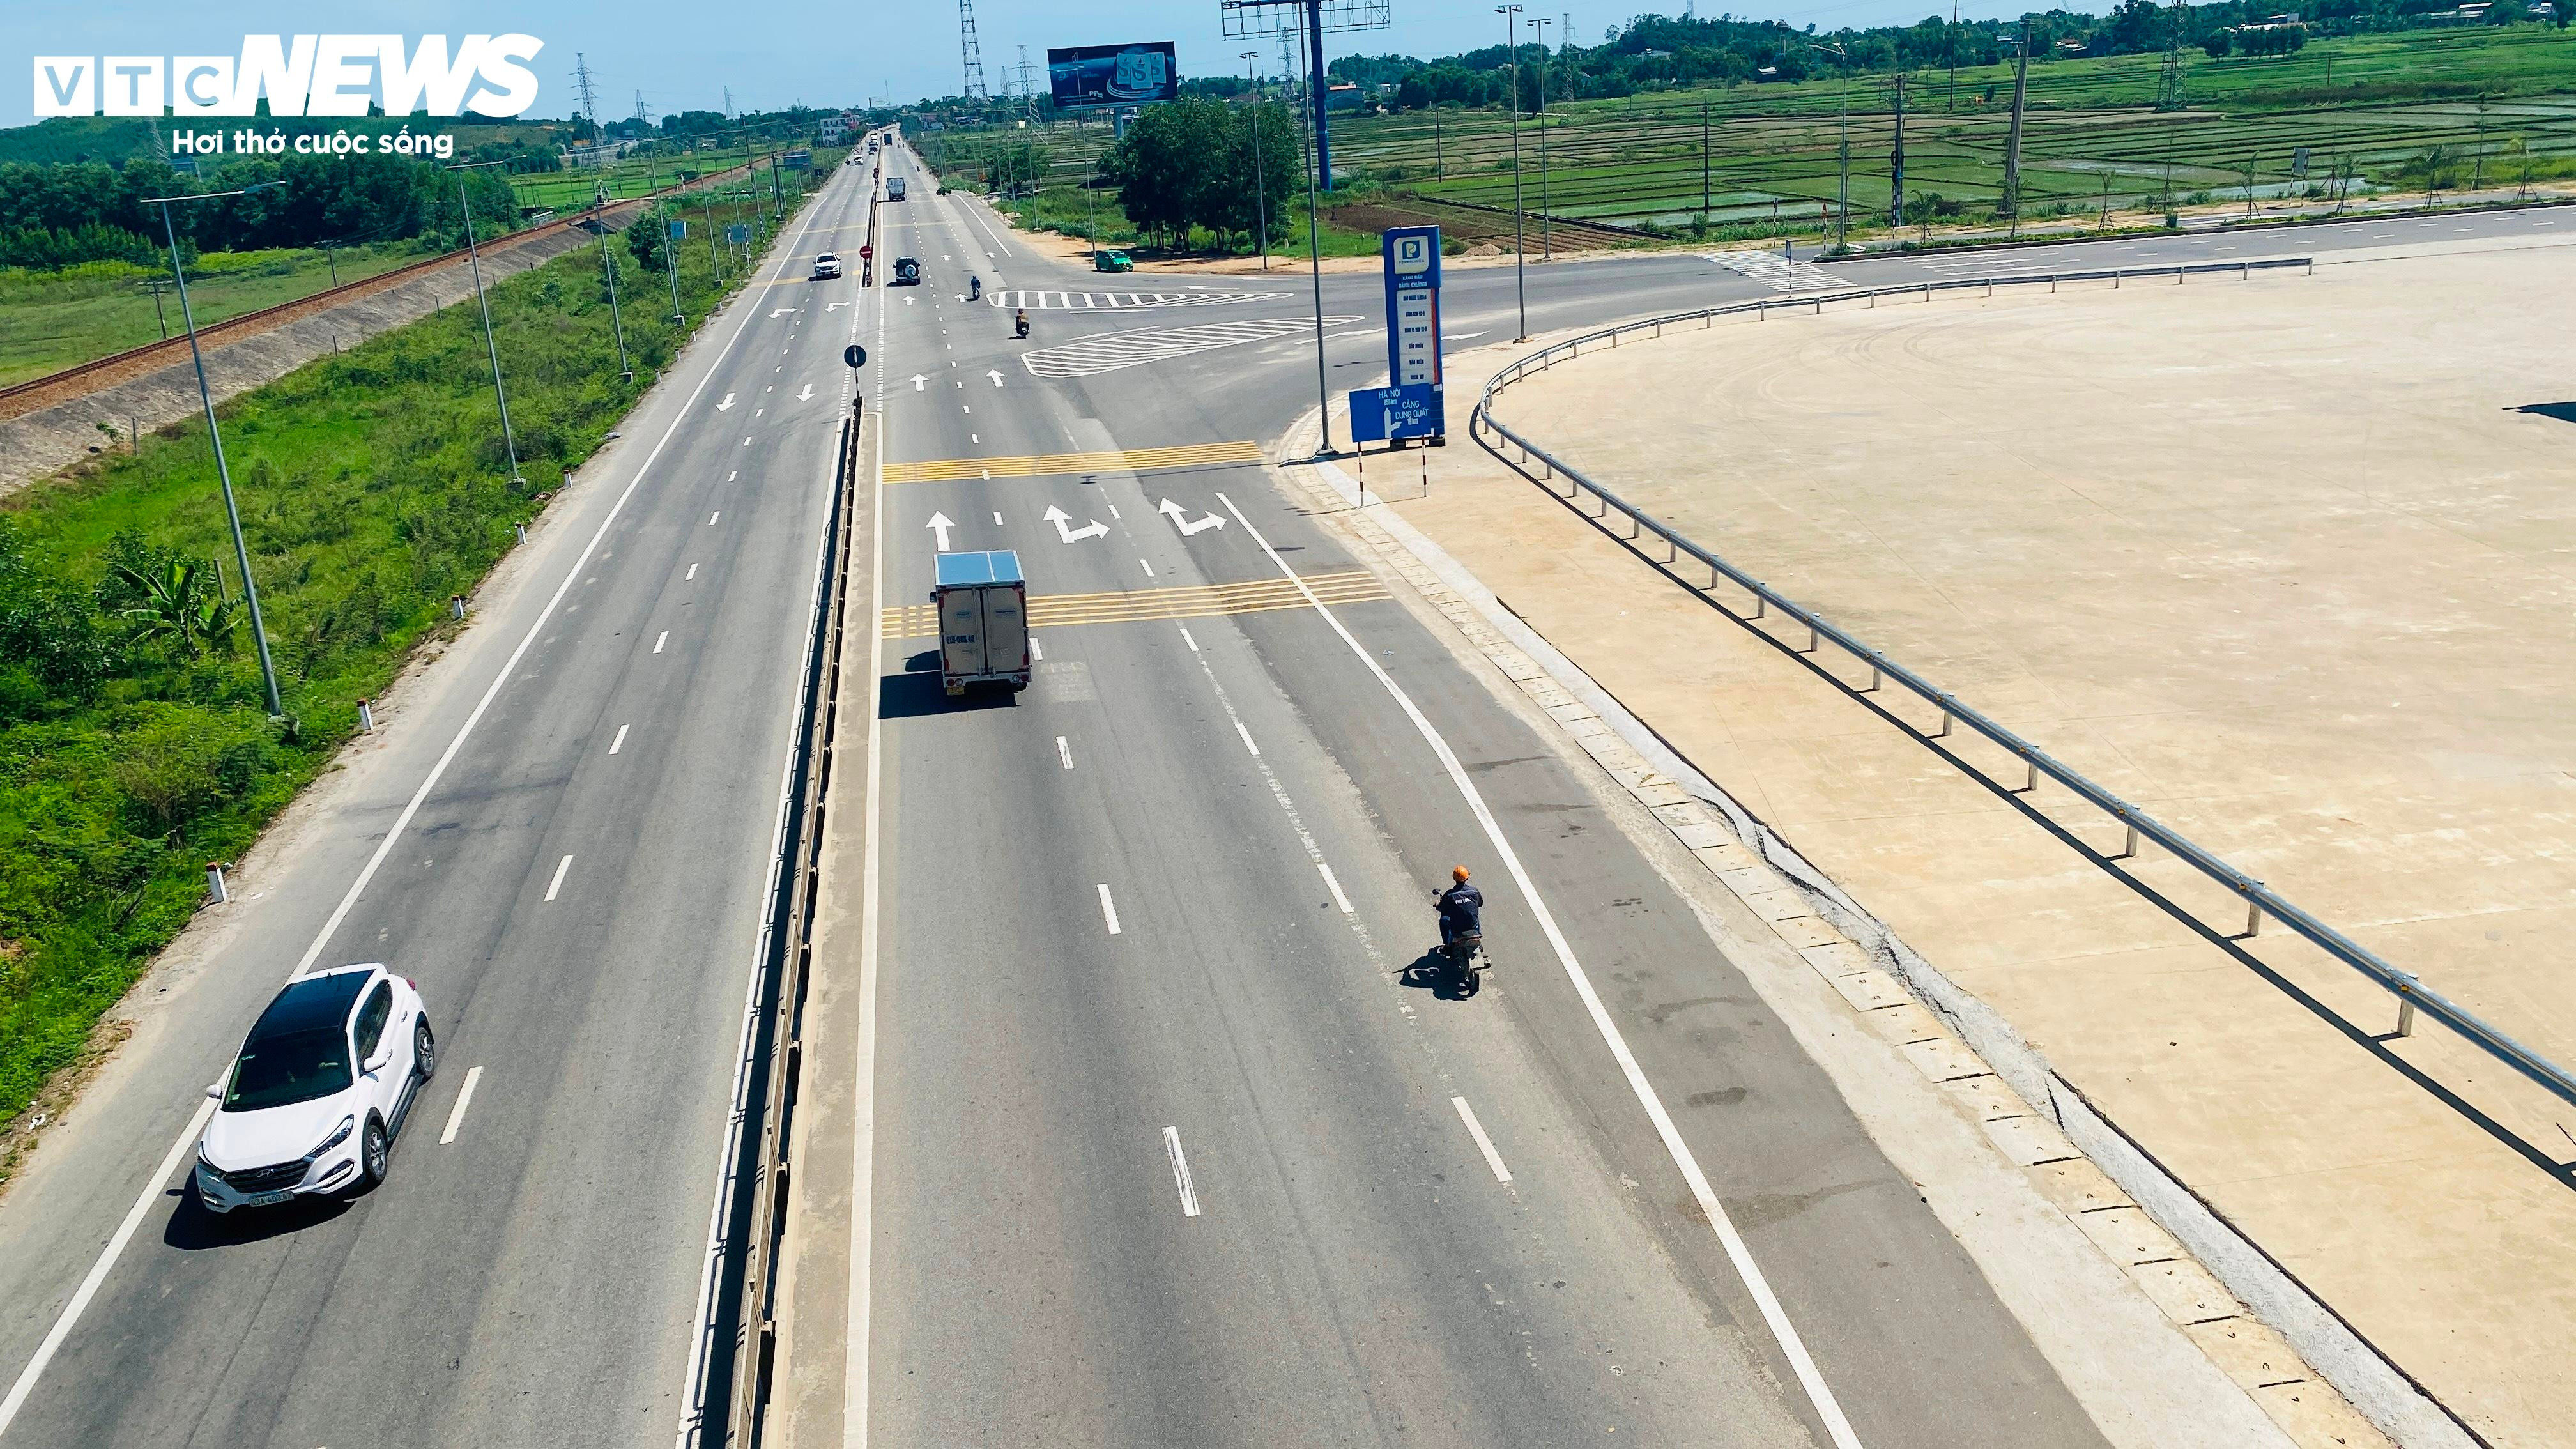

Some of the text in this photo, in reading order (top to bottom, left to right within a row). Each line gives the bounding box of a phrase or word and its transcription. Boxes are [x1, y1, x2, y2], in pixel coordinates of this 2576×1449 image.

[1378, 388, 1401, 399] HÀ NỘI
[1402, 399, 1420, 409] CẢNG
[1395, 407, 1429, 420] DUNG QUẤT
